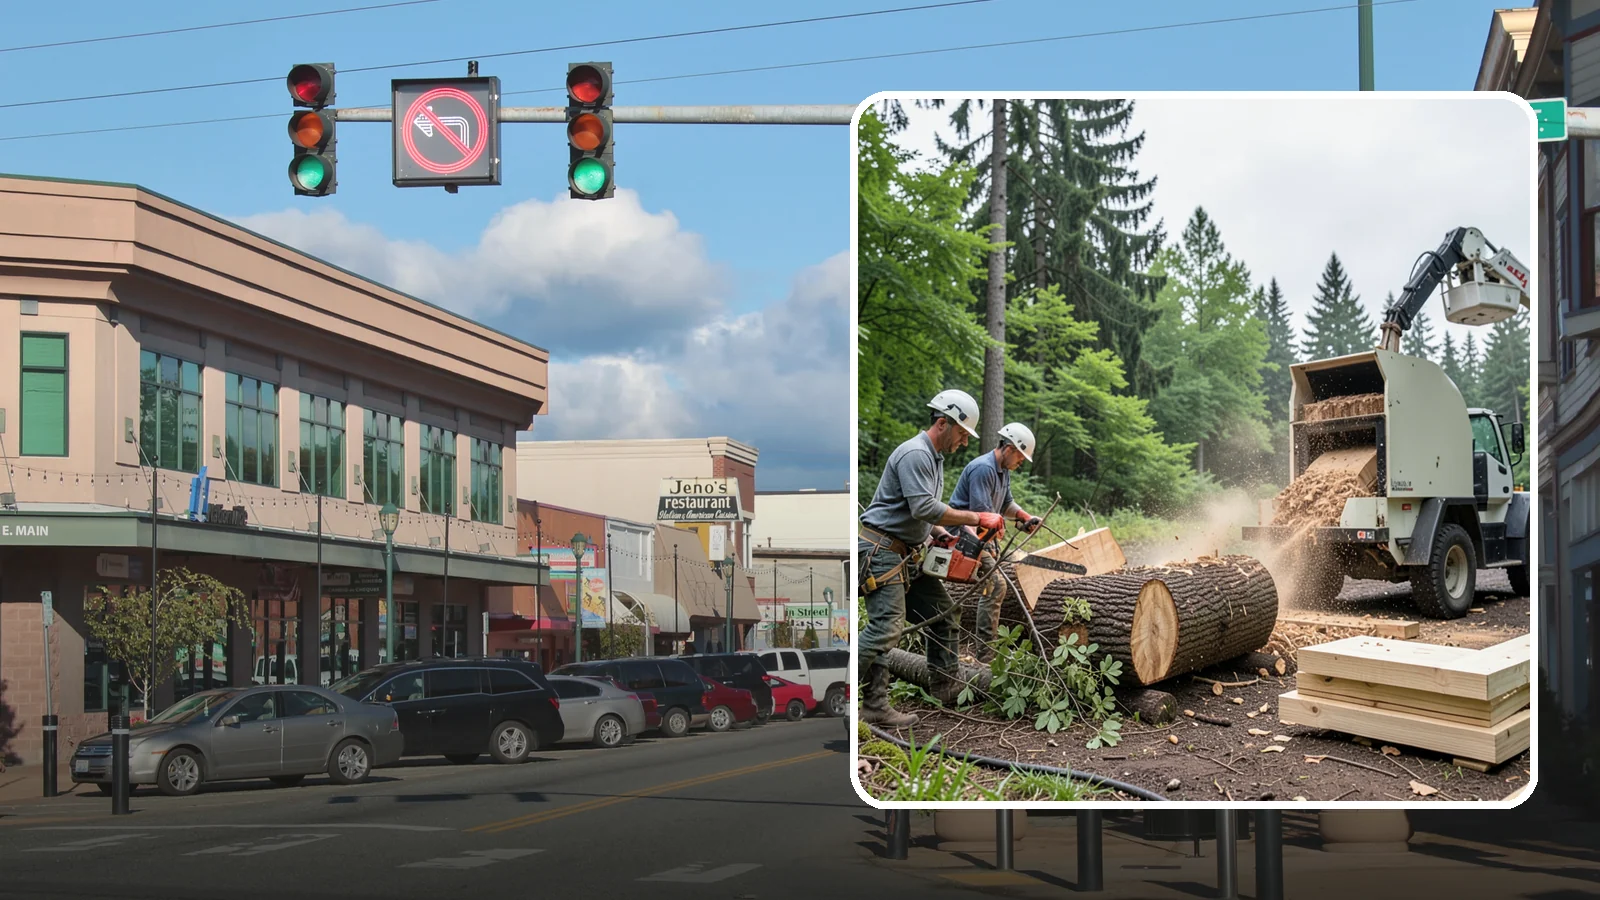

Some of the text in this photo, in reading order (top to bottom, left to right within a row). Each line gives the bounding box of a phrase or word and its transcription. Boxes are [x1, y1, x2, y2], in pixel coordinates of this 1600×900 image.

[670, 480, 728, 494] Jeno's
[665, 496, 731, 509] restaurant
[658, 510, 682, 520] Italian
[686, 510, 714, 519] American
[715, 510, 737, 519] Cuisine
[2, 525, 48, 536] E. MAIN
[797, 608, 828, 616] Street
